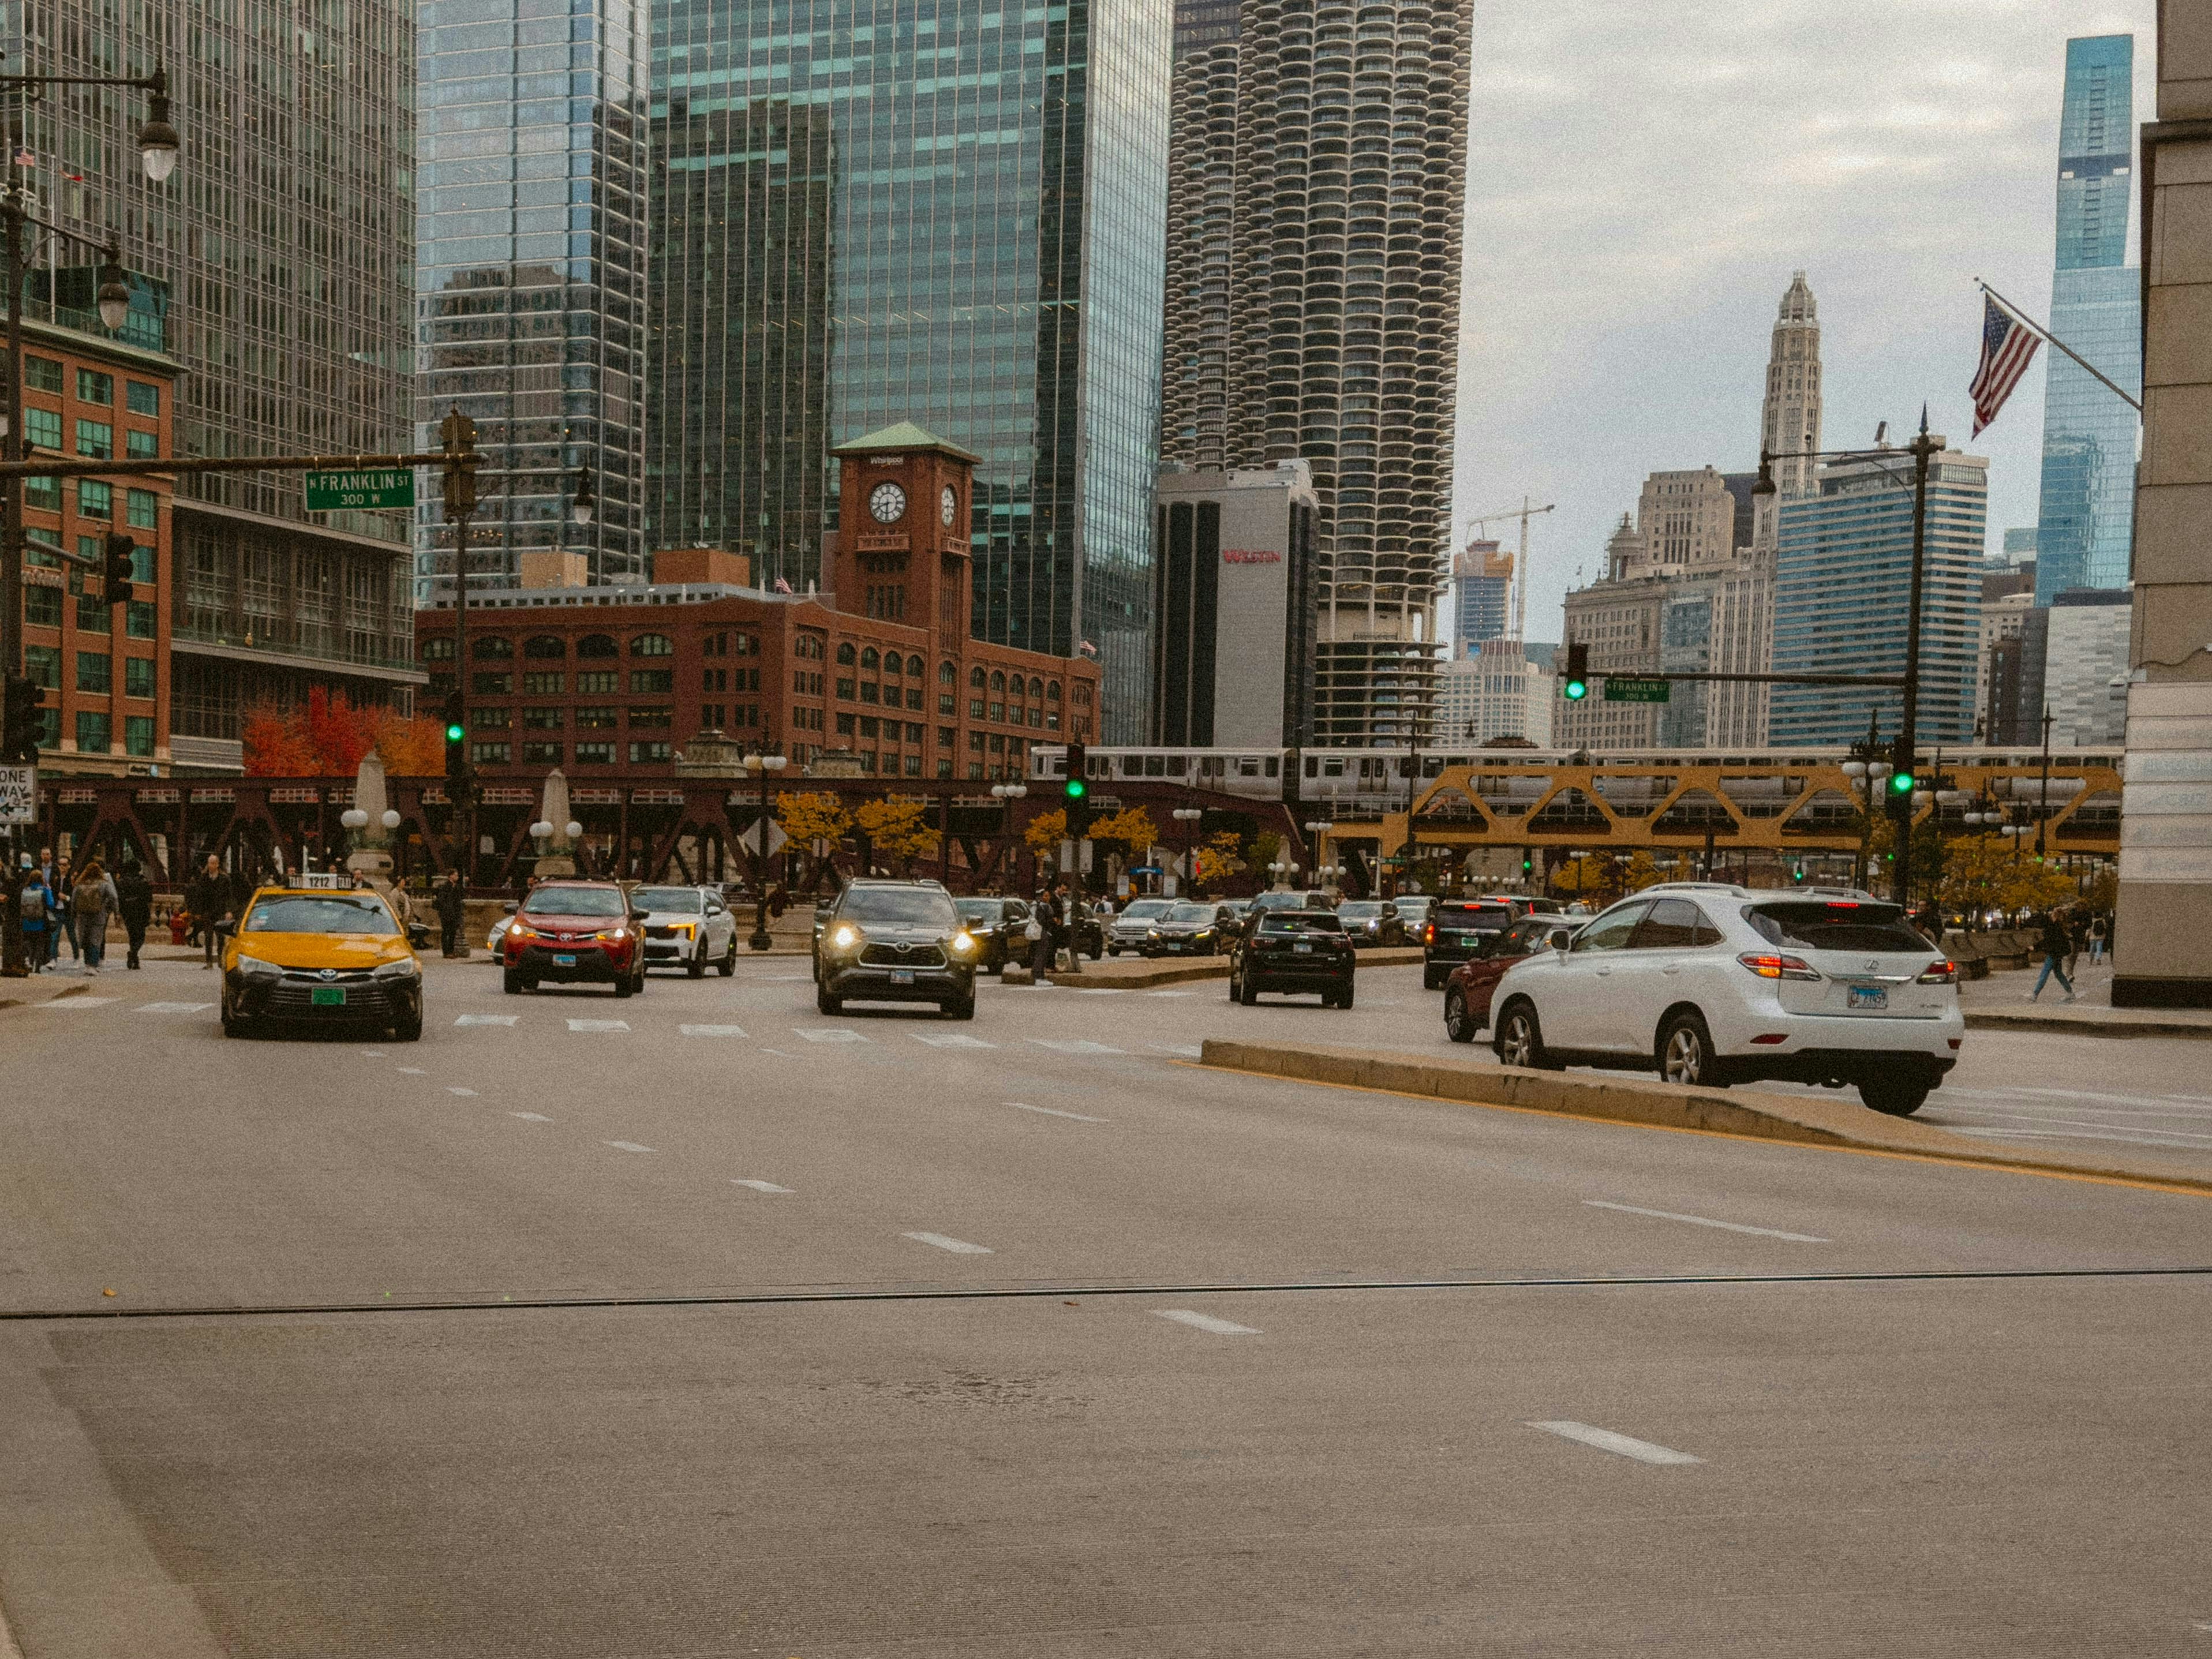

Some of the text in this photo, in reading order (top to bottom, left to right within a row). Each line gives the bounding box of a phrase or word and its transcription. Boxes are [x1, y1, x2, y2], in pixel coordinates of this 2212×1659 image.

[310, 474, 409, 490] N FRANKLIN ST
[340, 493, 380, 505] 300 W
[1613, 682, 1658, 692] FRANKLIN
[0, 770, 26, 782] ONE
[309, 877, 330, 887] 1212
